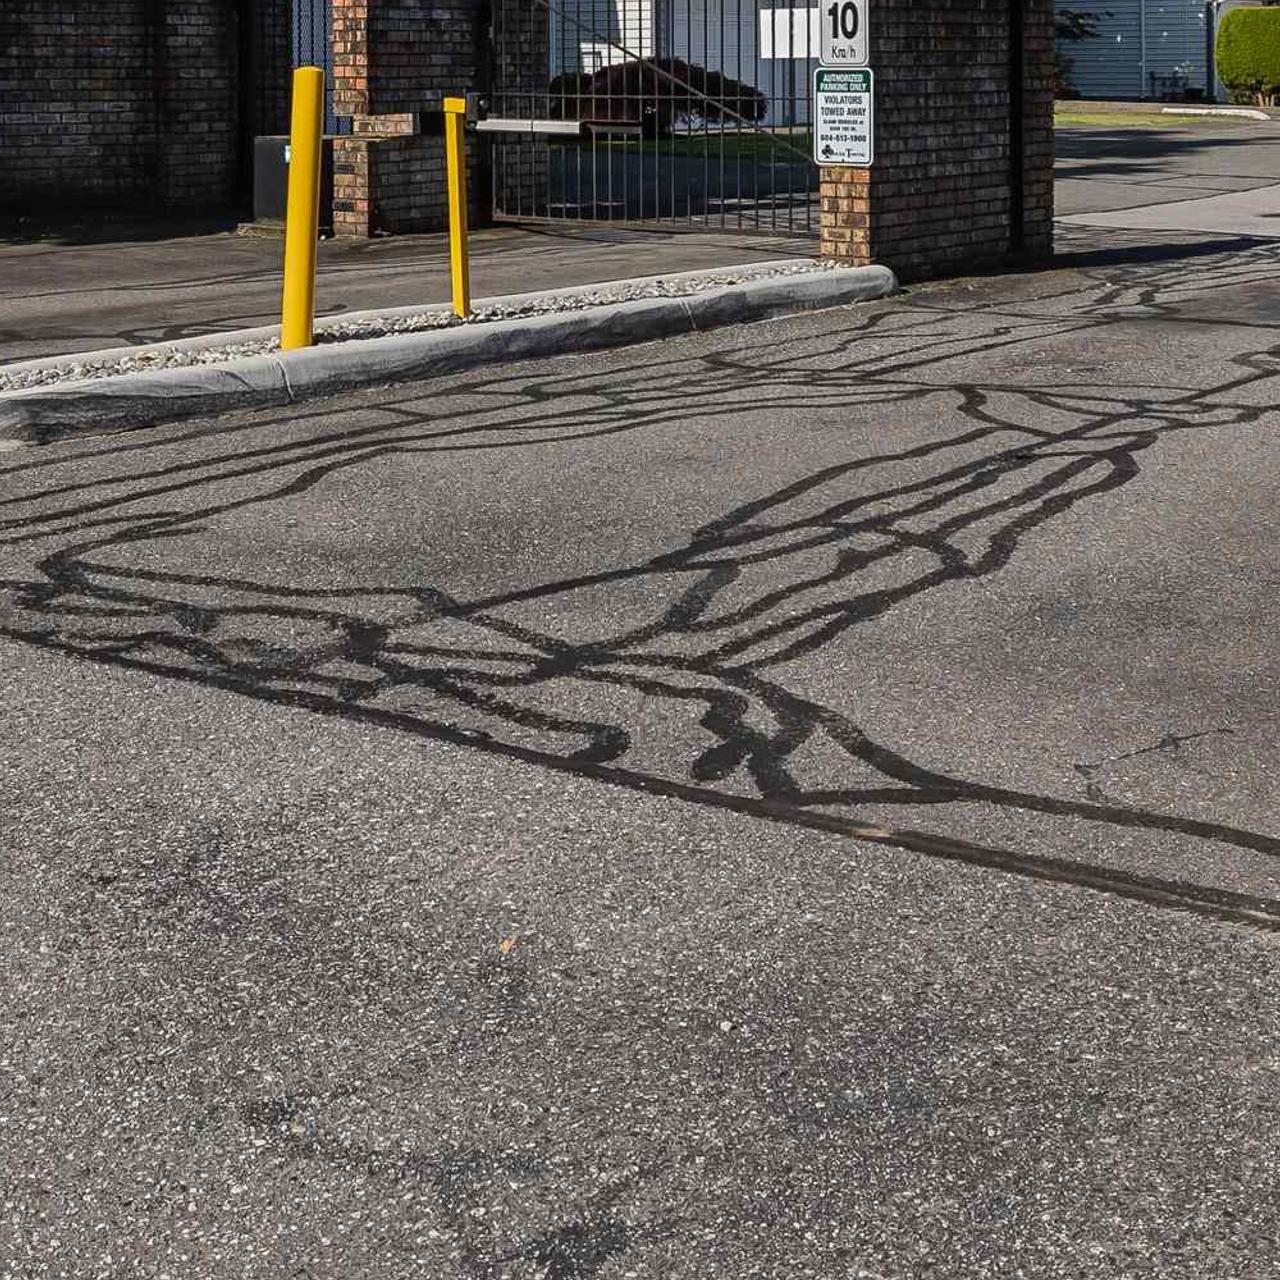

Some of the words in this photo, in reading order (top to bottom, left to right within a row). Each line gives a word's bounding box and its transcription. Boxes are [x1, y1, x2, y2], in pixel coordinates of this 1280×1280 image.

[827, 1, 859, 40] 10
[823, 73, 864, 82] AUTHORIZED
[820, 82, 849, 91] PARKING
[849, 82, 868, 91] ONLY
[824, 95, 863, 104] VIOLATORS
[821, 106, 844, 116] TOWED
[846, 106, 867, 116] AWAY
